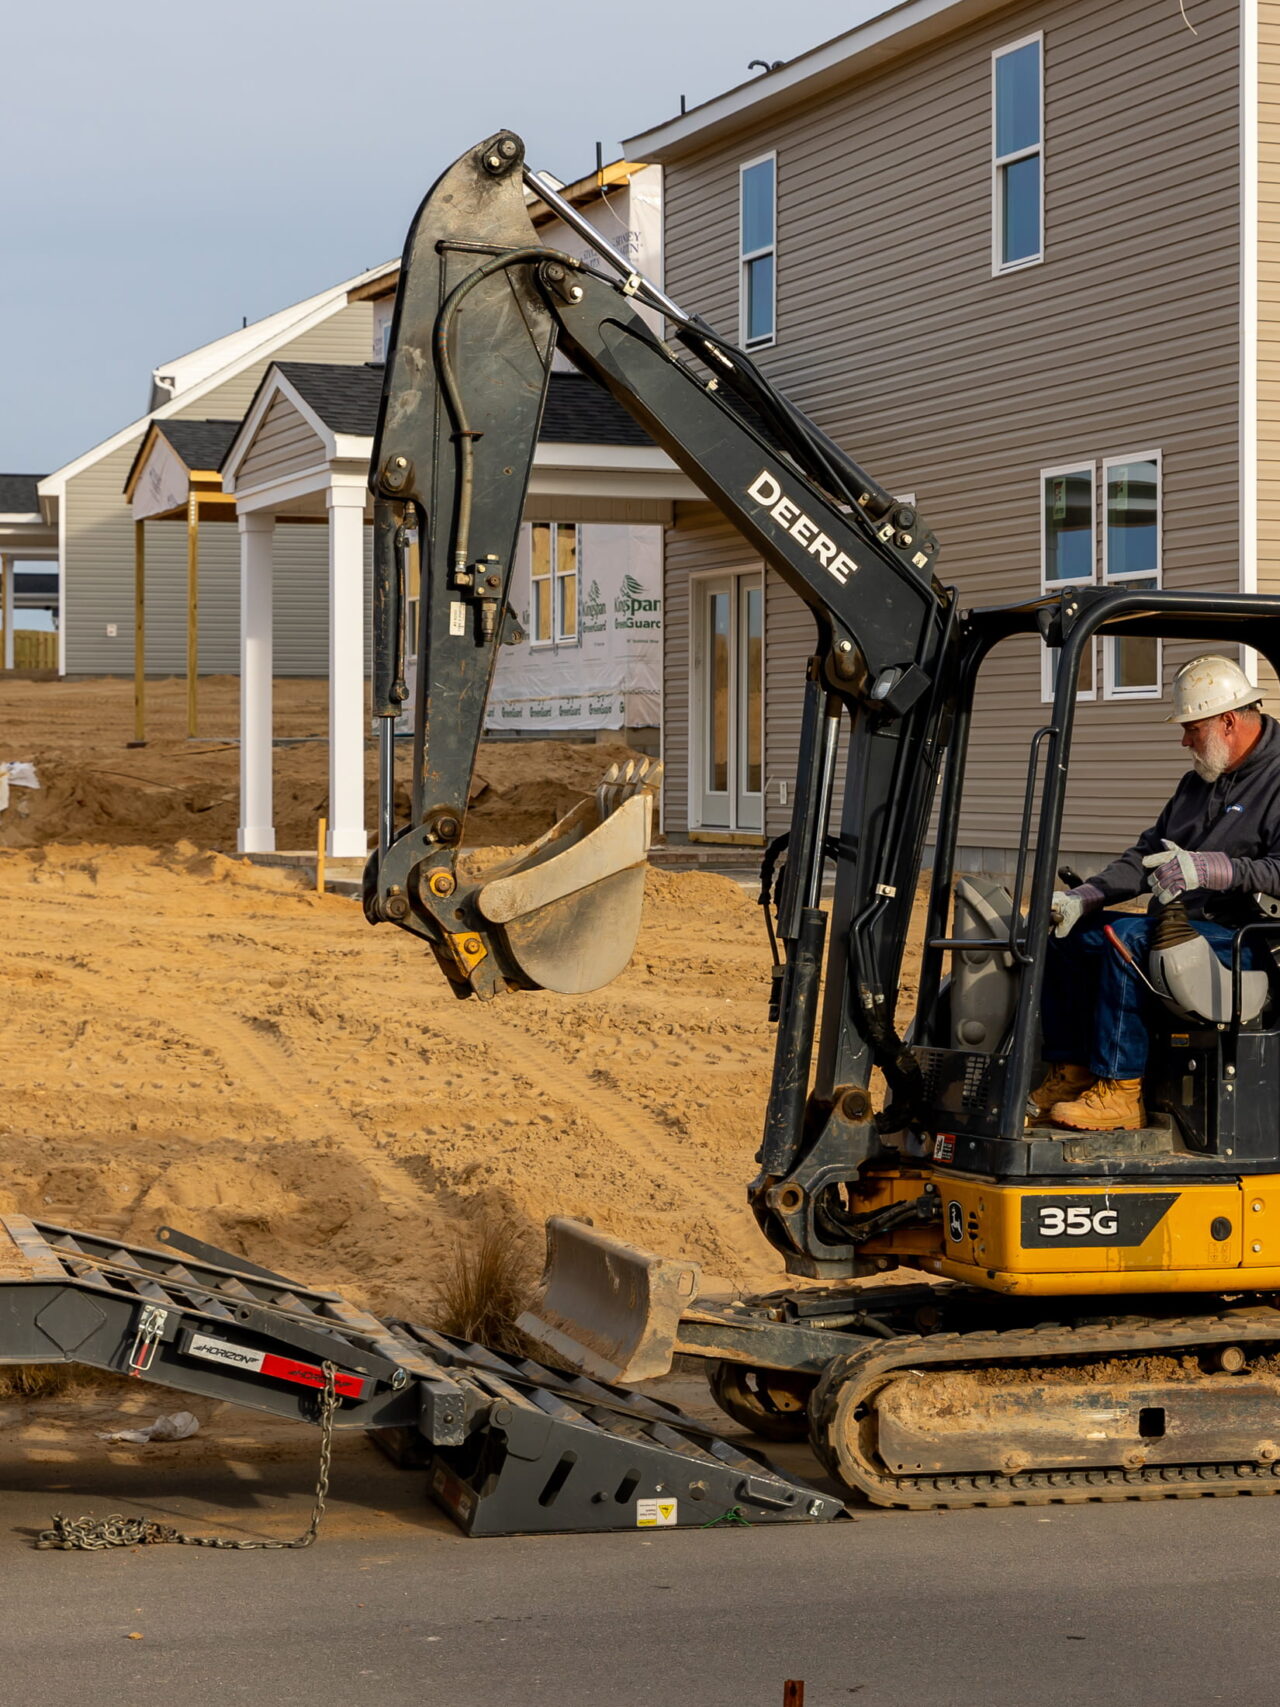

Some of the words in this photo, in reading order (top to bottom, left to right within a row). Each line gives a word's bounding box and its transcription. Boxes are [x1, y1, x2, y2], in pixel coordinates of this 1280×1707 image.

[747, 470, 858, 584] DEERE
[1038, 1206, 1119, 1237] 35G
[198, 1344, 253, 1364] HORIZON
